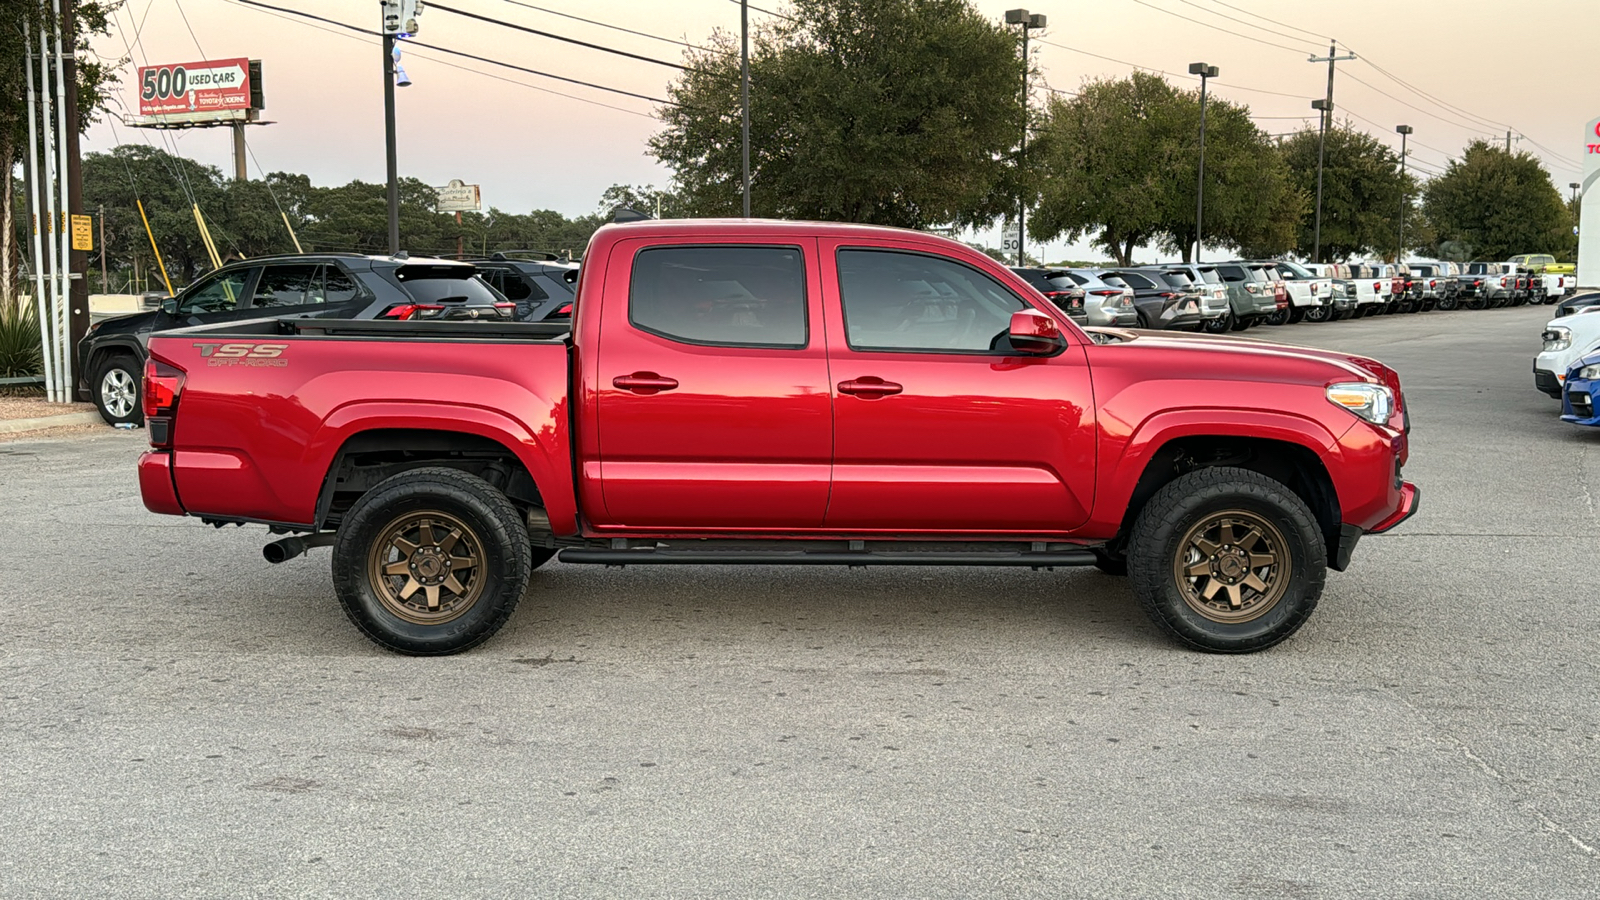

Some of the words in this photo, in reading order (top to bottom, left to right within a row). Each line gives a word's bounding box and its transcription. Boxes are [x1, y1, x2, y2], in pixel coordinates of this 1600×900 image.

[141, 66, 186, 101] 500
[189, 73, 211, 85] USED
[212, 71, 236, 83] CARS
[199, 97, 218, 105] TOYOTA
[1003, 239, 1019, 250] 50
[193, 343, 290, 358] TSS
[207, 358, 289, 367] OFF-ROAD
